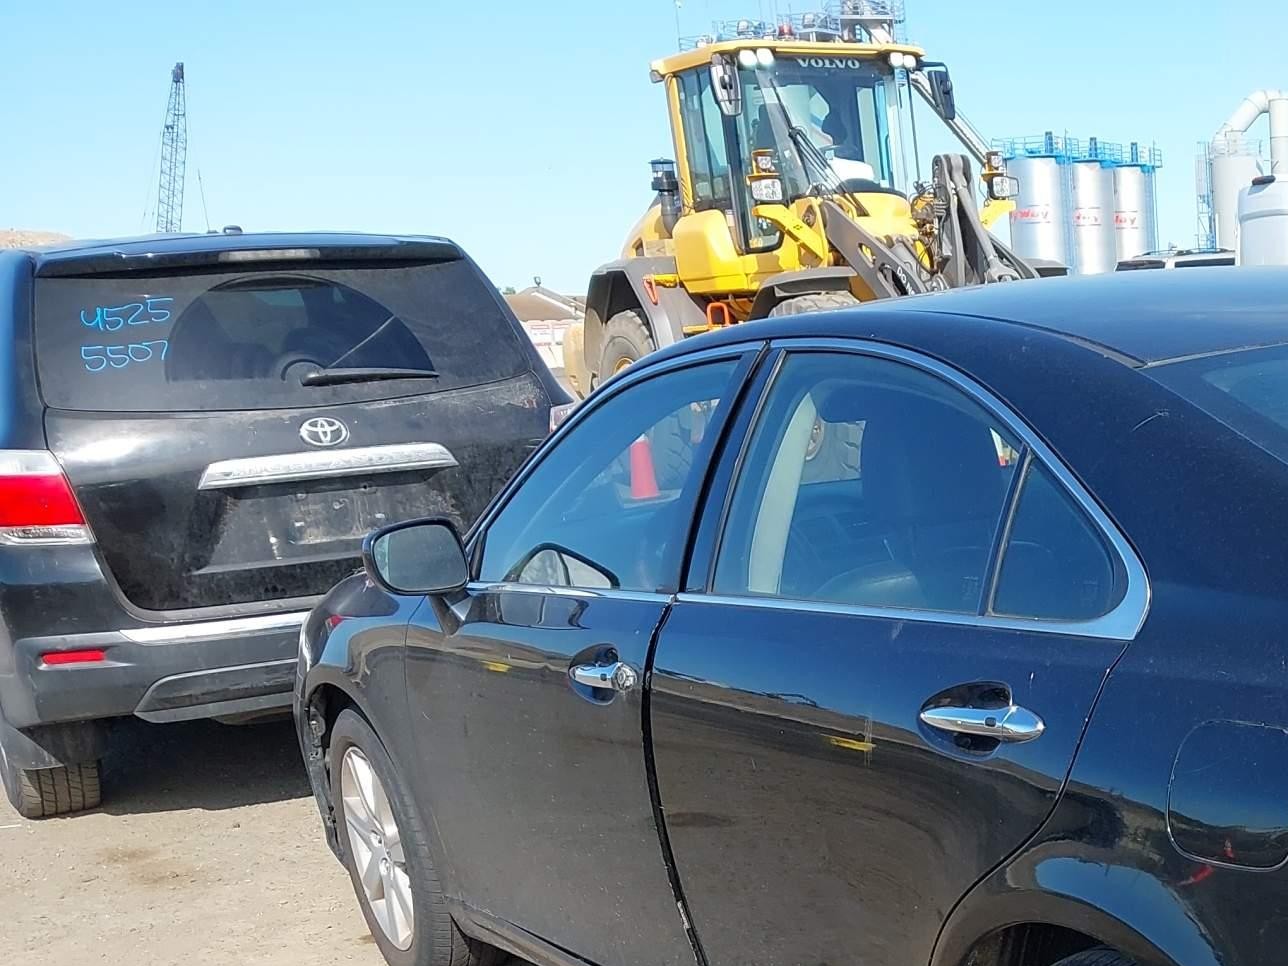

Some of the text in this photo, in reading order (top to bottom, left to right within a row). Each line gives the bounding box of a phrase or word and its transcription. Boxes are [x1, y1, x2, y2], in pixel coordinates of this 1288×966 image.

[796, 57, 860, 69] VOLVO
[81, 297, 174, 331] 4525
[80, 340, 169, 371] 5507
